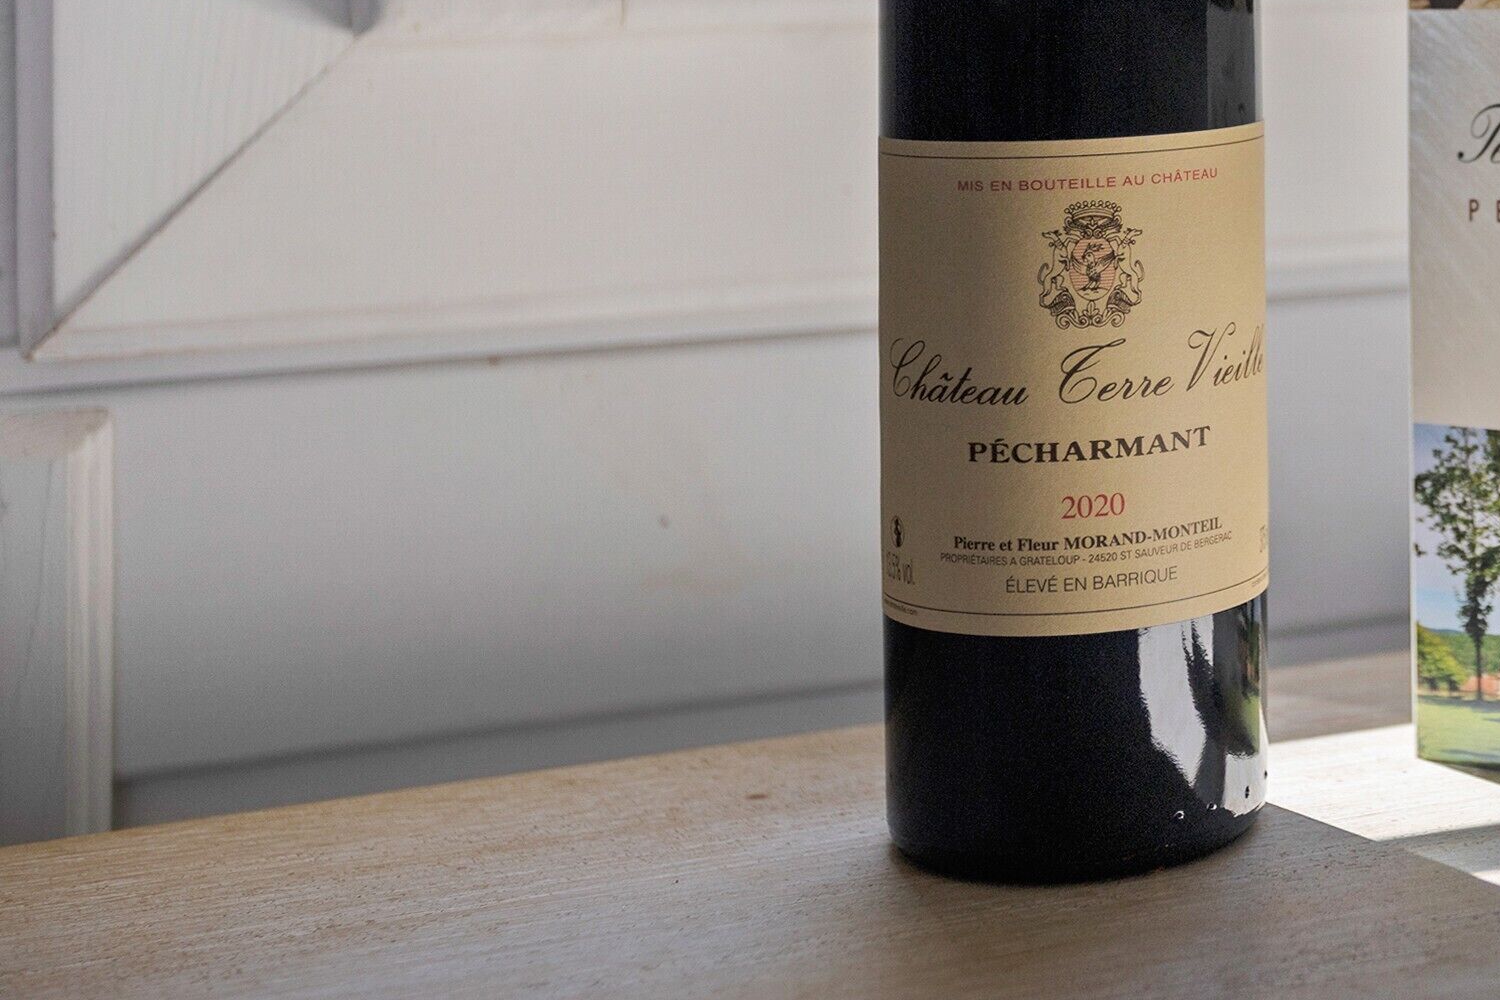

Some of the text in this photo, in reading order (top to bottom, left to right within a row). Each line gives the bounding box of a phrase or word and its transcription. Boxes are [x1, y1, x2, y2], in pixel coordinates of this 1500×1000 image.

[957, 167, 1218, 191] MIS EN BOUTEILLE AU CHÂTEAU
[890, 338, 1028, 405] Château
[1059, 338, 1174, 404] Terre
[968, 425, 1211, 464] PÉCHARMANT
[1060, 492, 1126, 519] 2020
[953, 516, 1223, 552] Pierre et Fleur MORAND-MONTEIL
[1019, 553, 1081, 566] GRATELOUP
[1088, 553, 1118, 564] 24520
[1120, 549, 1132, 561] ST
[1134, 543, 1179, 560] SAUVEUR
[1180, 539, 1193, 551] DE
[1005, 565, 1179, 594] ÉLEVÉ EN BARRIQUE
